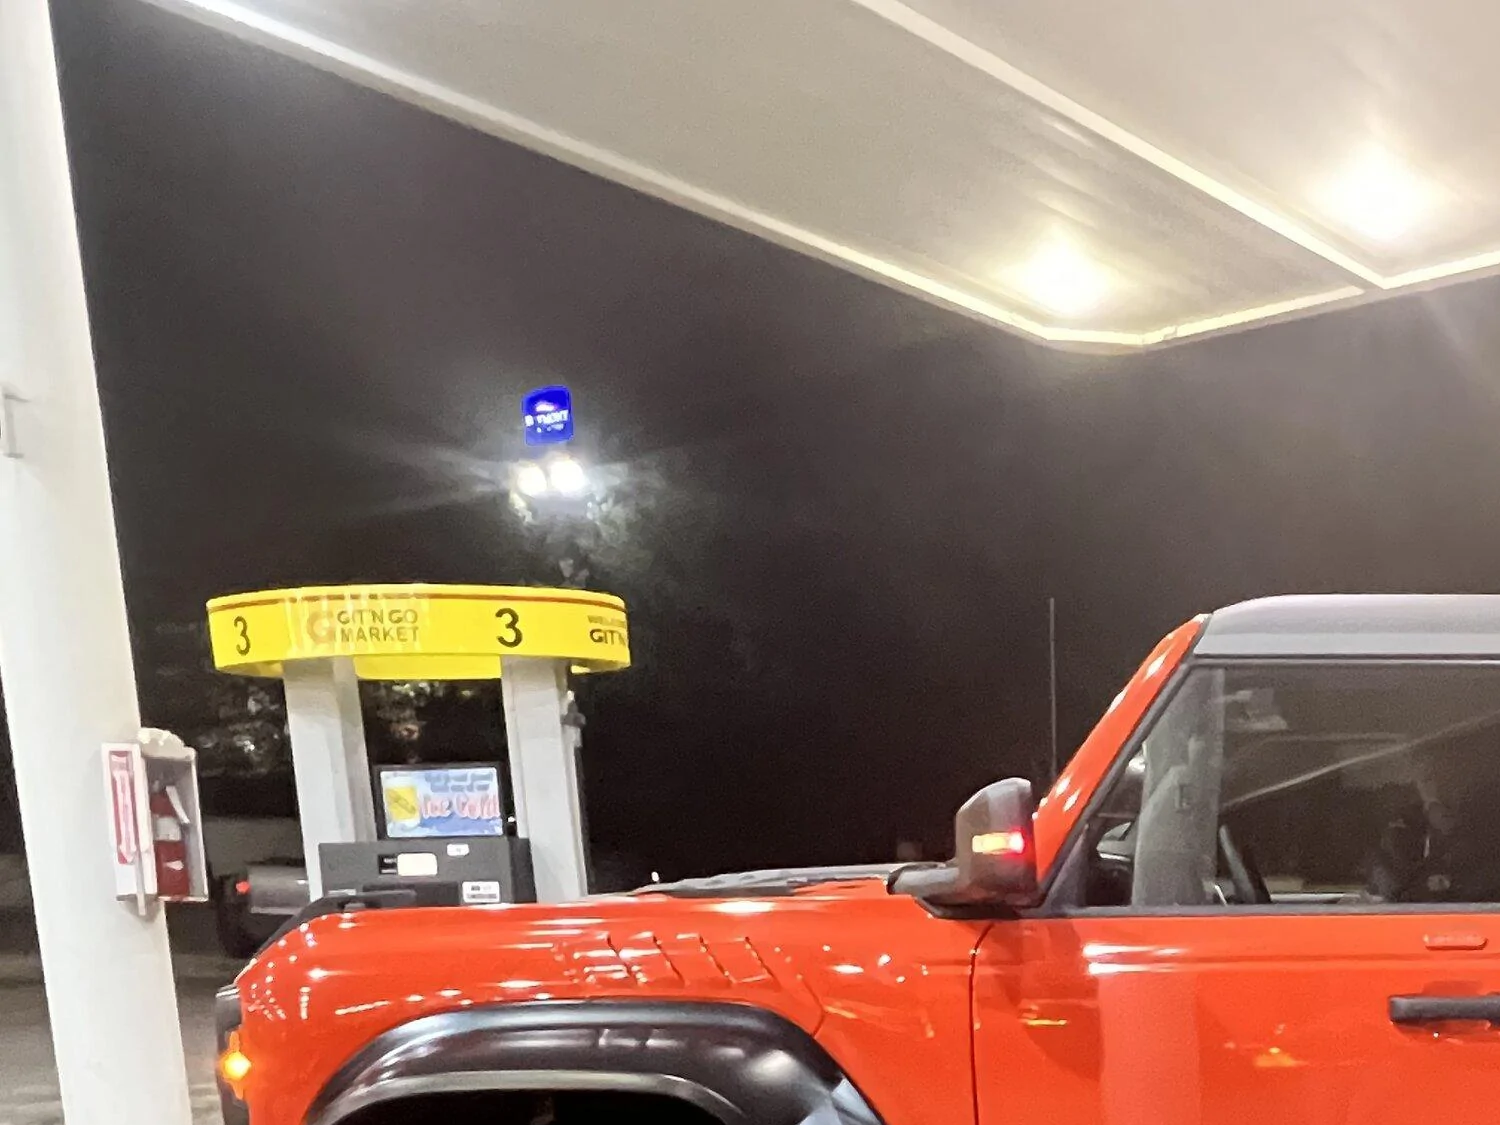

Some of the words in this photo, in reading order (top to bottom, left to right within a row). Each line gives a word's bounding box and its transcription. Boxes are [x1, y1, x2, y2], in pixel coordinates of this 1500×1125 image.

[388, 609, 419, 624] GO
[495, 607, 523, 648] 3
[234, 616, 250, 656] 3
[340, 625, 419, 643] MARKET
